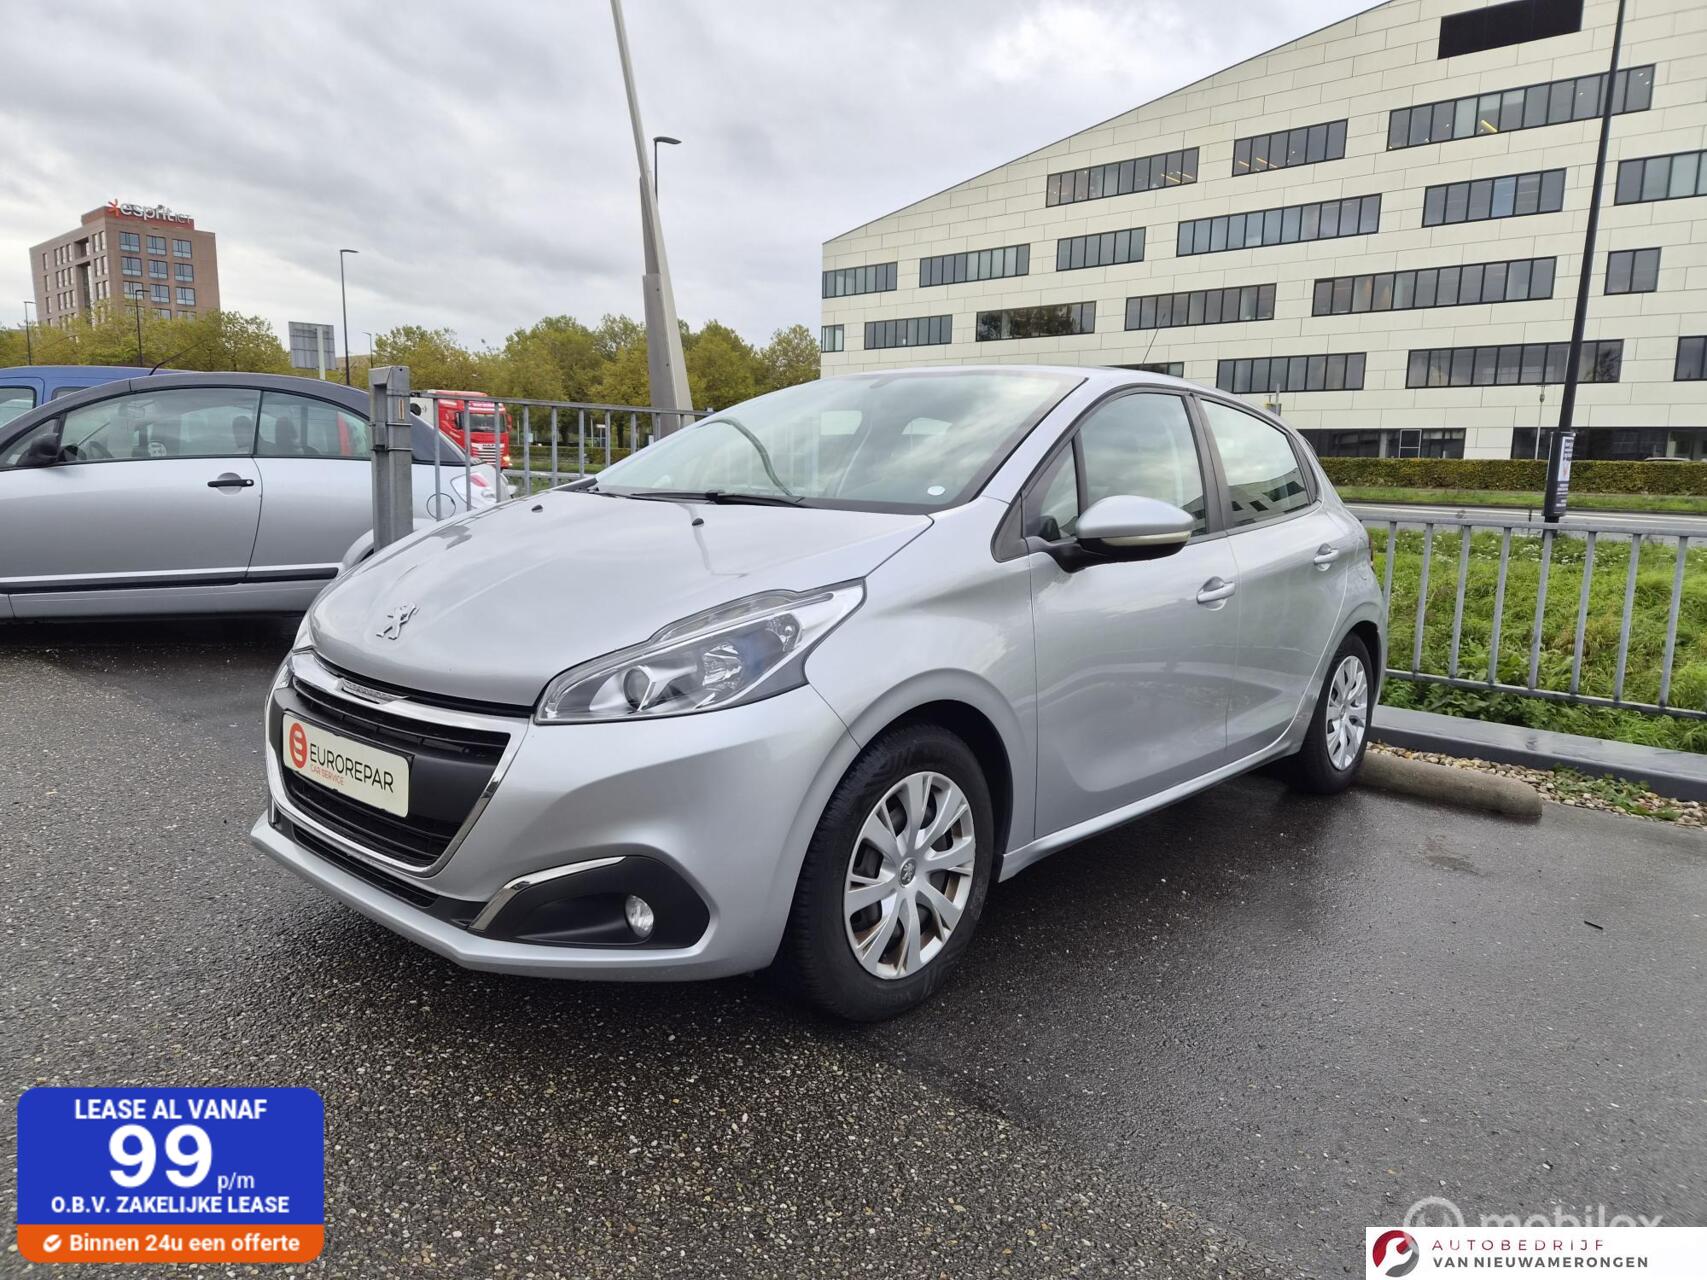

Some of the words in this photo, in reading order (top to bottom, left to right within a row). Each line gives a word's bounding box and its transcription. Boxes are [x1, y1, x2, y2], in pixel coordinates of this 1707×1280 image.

[120, 203, 173, 221] esprit
[309, 743, 394, 793] EUROREPAR
[310, 764, 320, 776] CAR
[320, 768, 344, 786] SERVICE
